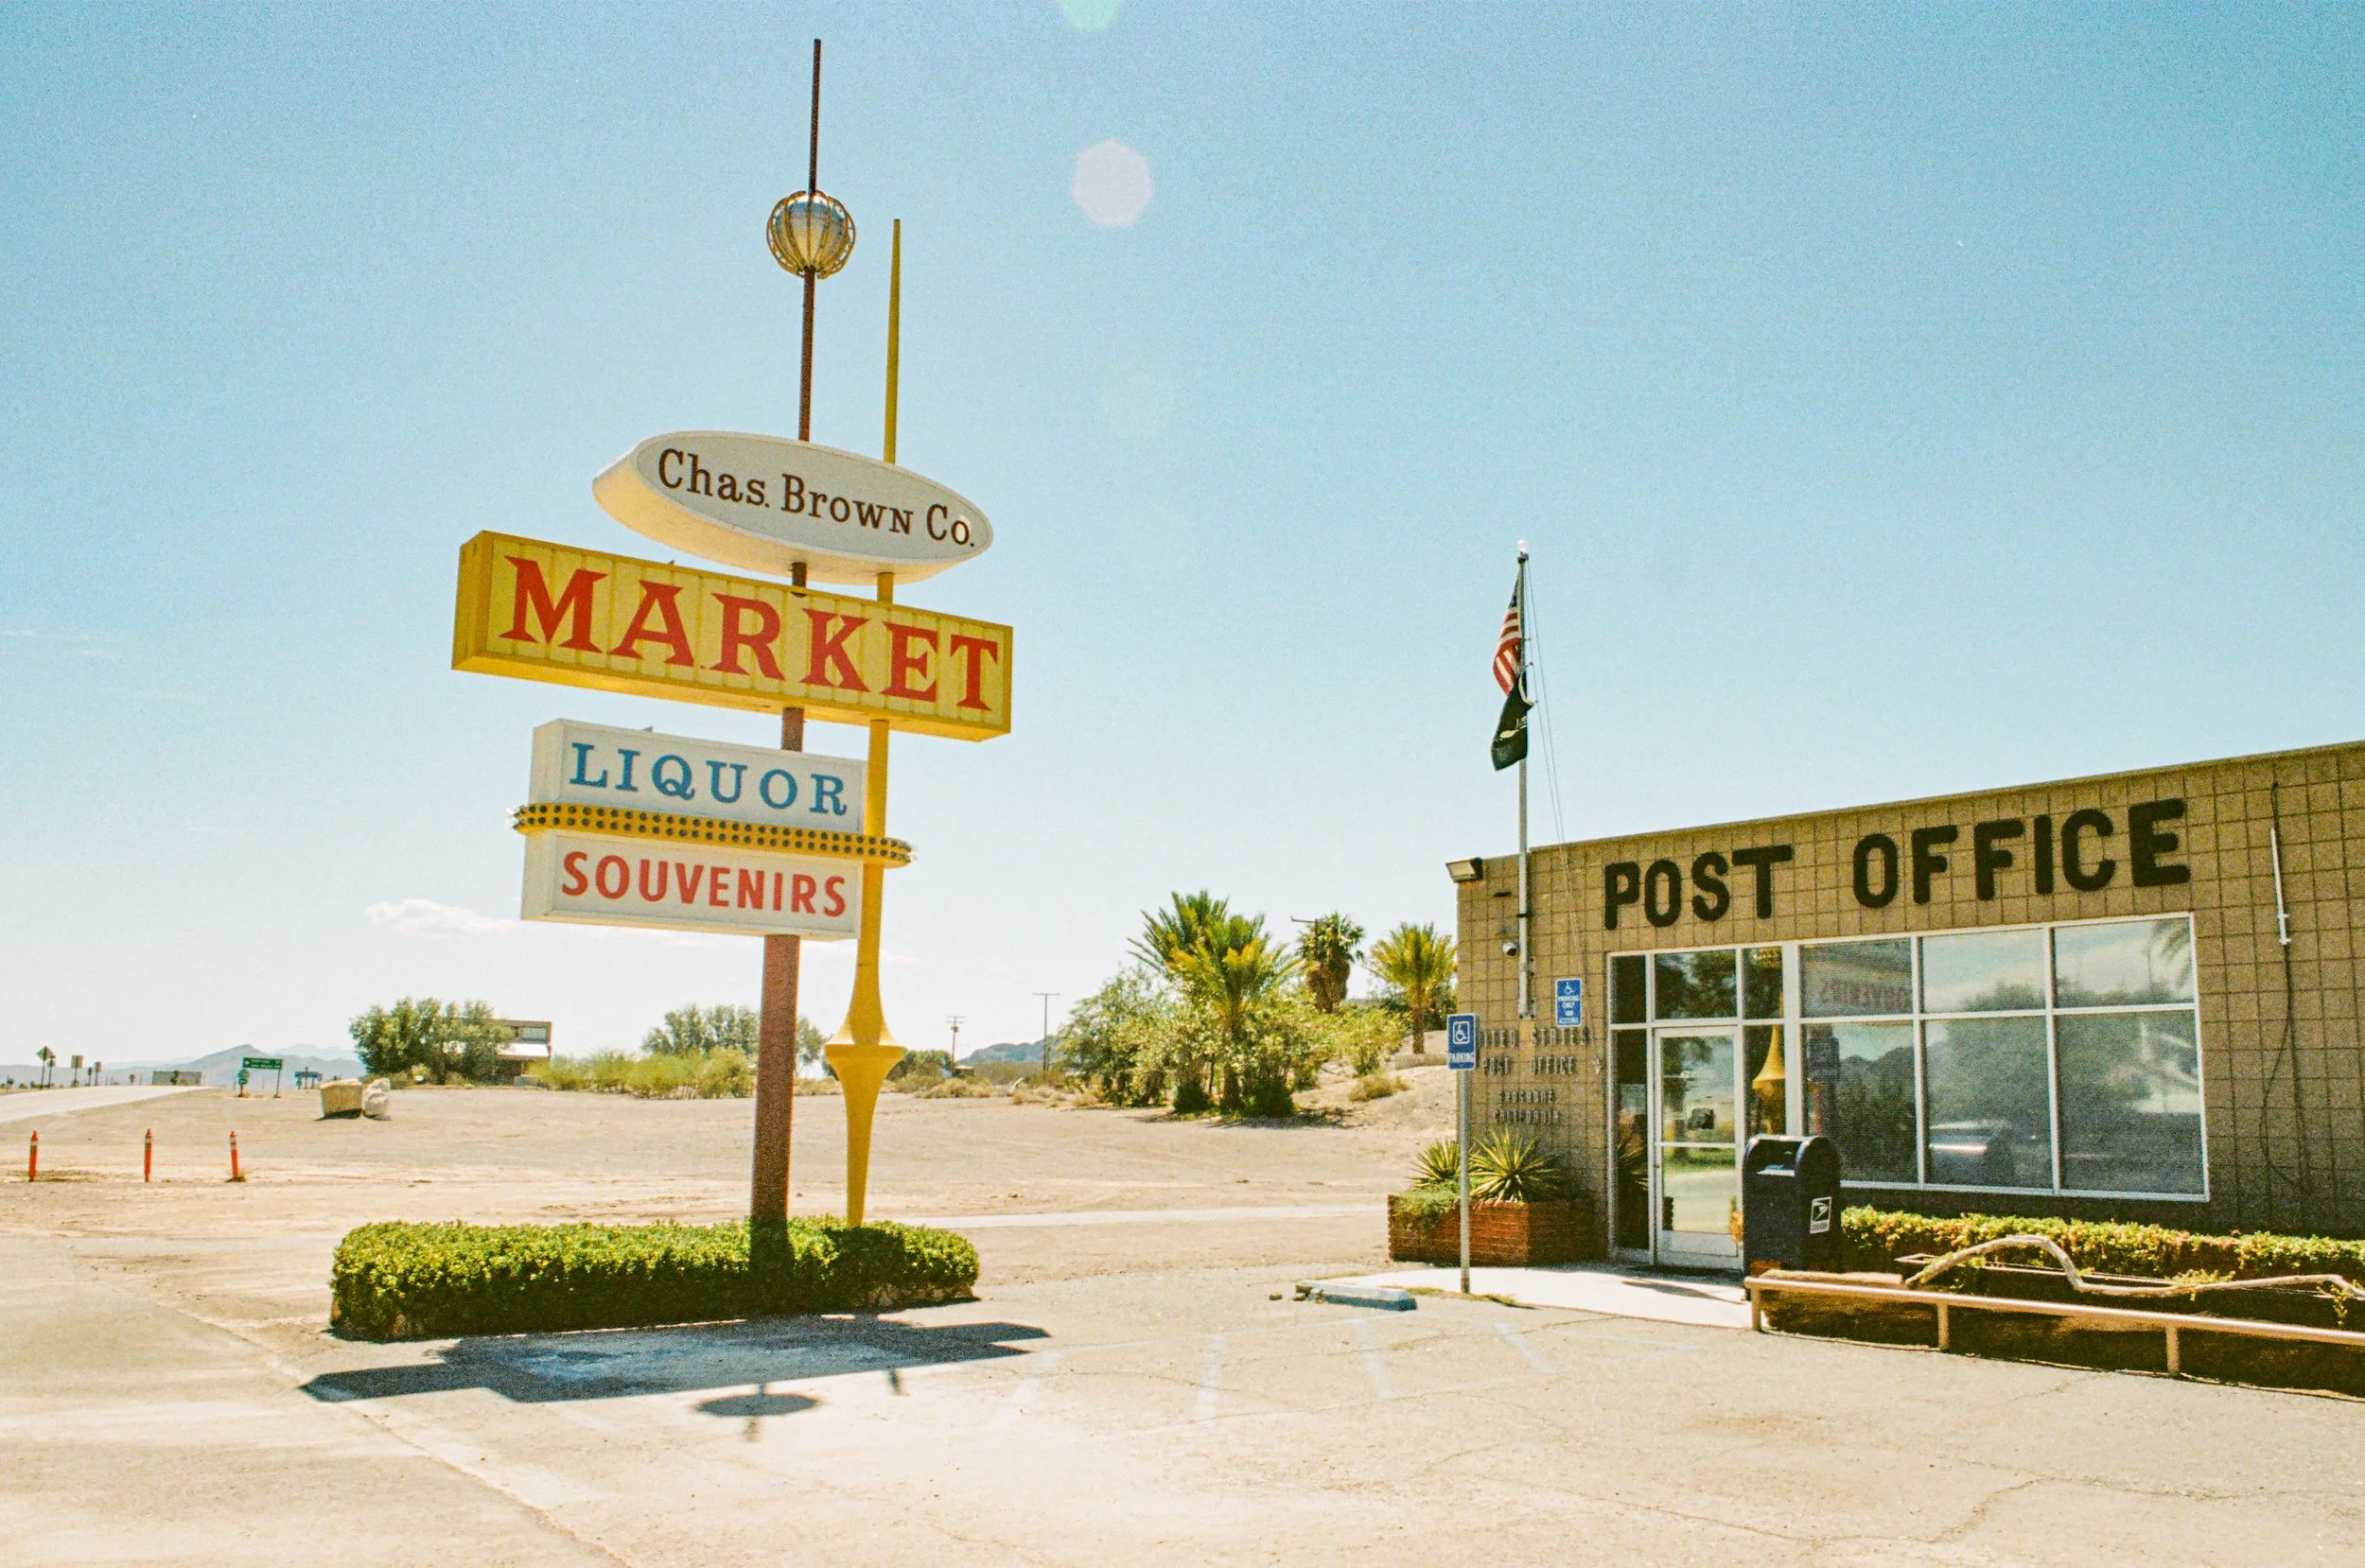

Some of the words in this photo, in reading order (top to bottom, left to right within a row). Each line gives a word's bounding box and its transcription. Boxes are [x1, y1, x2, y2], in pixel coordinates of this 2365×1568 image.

[657, 447, 770, 509] Chas.
[926, 503, 975, 548] Co.
[499, 556, 998, 712] MARKET
[569, 741, 848, 816] LIQUOR
[562, 850, 847, 917] SOUVENIRS
[1603, 843, 1796, 932] POST
[1851, 797, 2192, 910] OFFICE
[1448, 1052, 1475, 1064] PARKING
[1482, 1056, 1511, 1076] POST
[1529, 1055, 1576, 1075] OFFICE
